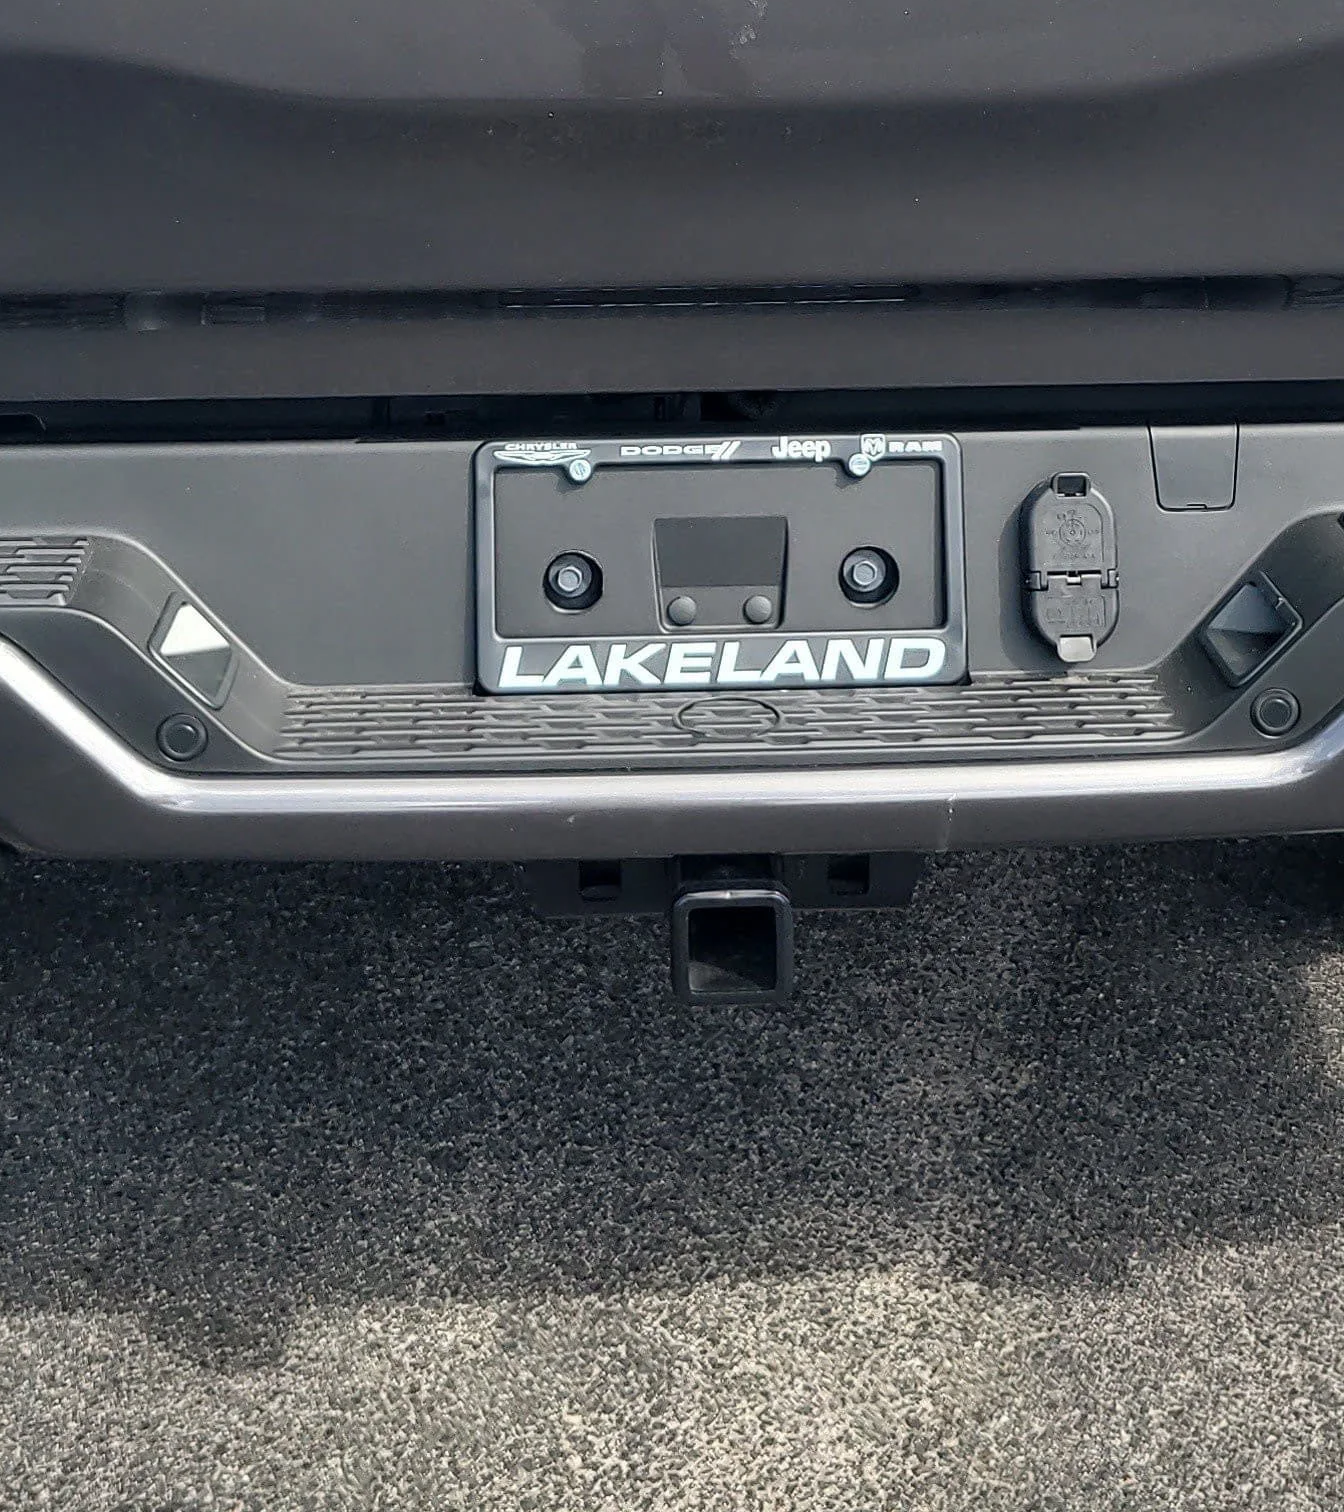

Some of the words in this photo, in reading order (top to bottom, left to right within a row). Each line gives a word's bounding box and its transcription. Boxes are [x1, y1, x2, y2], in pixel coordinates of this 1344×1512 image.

[504, 441, 579, 452] CHRYSLER
[771, 436, 832, 463] Jeep
[888, 439, 943, 453] RAM
[498, 637, 947, 688] LAKELAND
